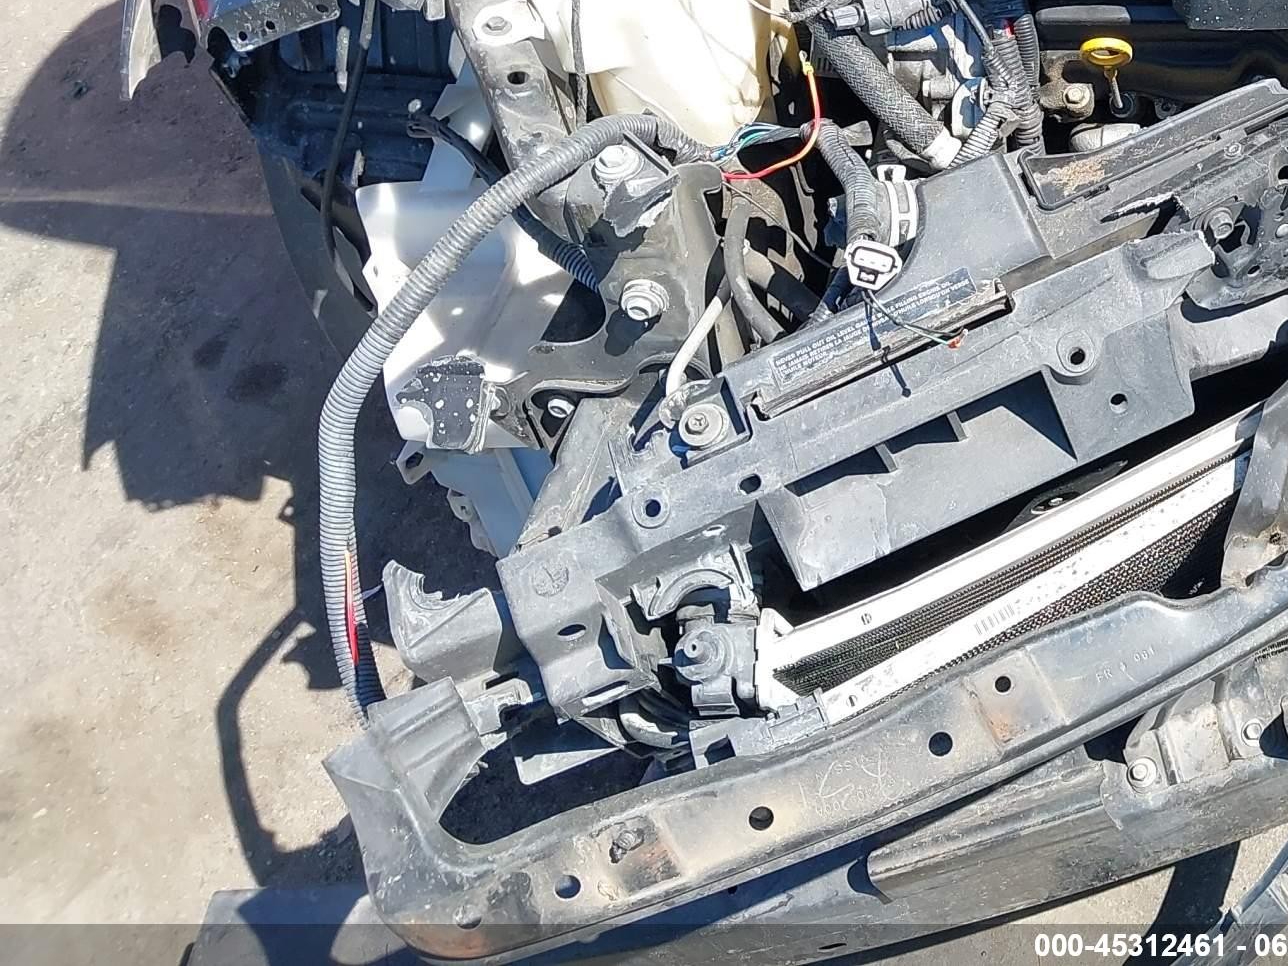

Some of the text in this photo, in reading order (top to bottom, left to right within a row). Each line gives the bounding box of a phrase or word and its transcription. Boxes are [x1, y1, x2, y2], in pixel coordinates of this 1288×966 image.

[796, 346, 811, 355] PULL
[812, 339, 825, 348] OUT
[837, 325, 855, 336] LEVEL
